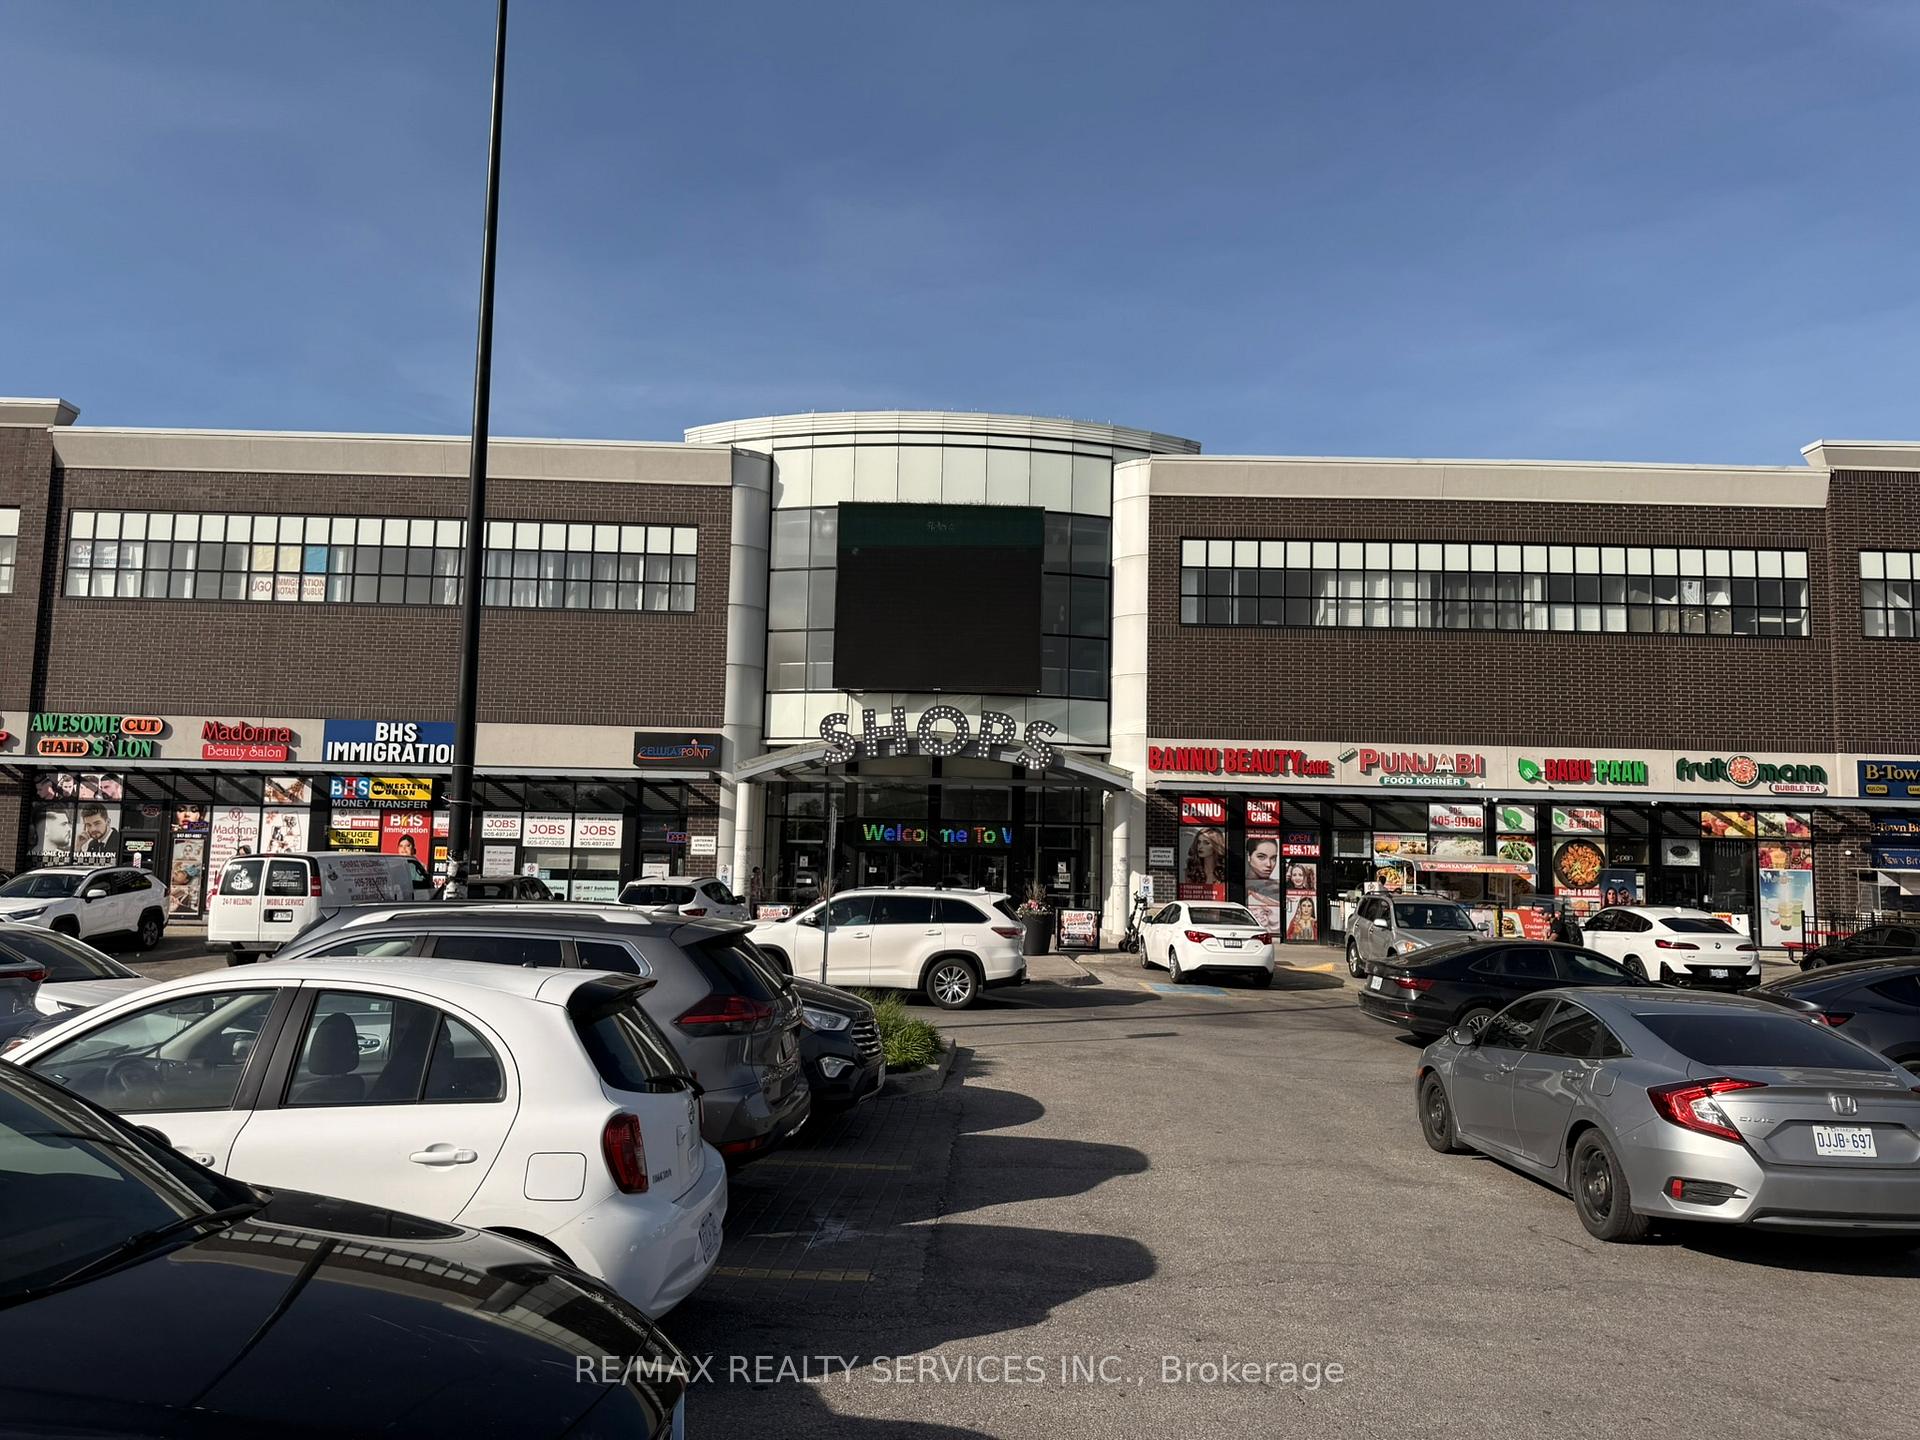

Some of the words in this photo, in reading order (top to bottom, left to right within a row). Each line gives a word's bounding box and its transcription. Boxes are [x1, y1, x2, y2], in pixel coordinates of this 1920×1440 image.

[31, 713, 119, 733] AWESOME
[125, 719, 158, 731] CUT
[201, 721, 291, 742] Madonna
[375, 722, 418, 742] BHS
[819, 705, 1058, 771] SHOPS
[41, 741, 84, 753] HAIR
[207, 745, 246, 760] Beauty
[249, 746, 281, 757] Salon
[327, 742, 455, 763] IMMIGRATIO
[1148, 746, 1217, 772] BANNU
[1224, 748, 1303, 775] BEAUTY
[1302, 761, 1329, 774] CARE
[1359, 749, 1482, 774] PUNJABI
[1545, 759, 1592, 782] BABU
[1597, 760, 1645, 783] PAAN
[1676, 758, 1727, 780] fruit
[1759, 764, 1827, 784] mann
[1383, 777, 1413, 785] FOOD
[1416, 777, 1460, 785] KORNER
[331, 780, 369, 796] BHS
[331, 799, 370, 807] MONEY
[373, 801, 428, 809] TRANSFER
[1182, 803, 1221, 816] BANNU
[1247, 801, 1276, 811] BEAUTY
[391, 814, 423, 827] BHS
[1251, 812, 1272, 821] CARE
[1432, 816, 1482, 827] 405-9998
[213, 826, 257, 834] Madonna
[487, 820, 516, 828] JOBS
[529, 825, 565, 834] JOBS
[580, 826, 616, 835] JOBS
[1870, 823, 1906, 832] B-Town
[973, 827, 996, 843] To
[267, 898, 283, 906] MOBILE
[285, 898, 304, 906] SERVICE
